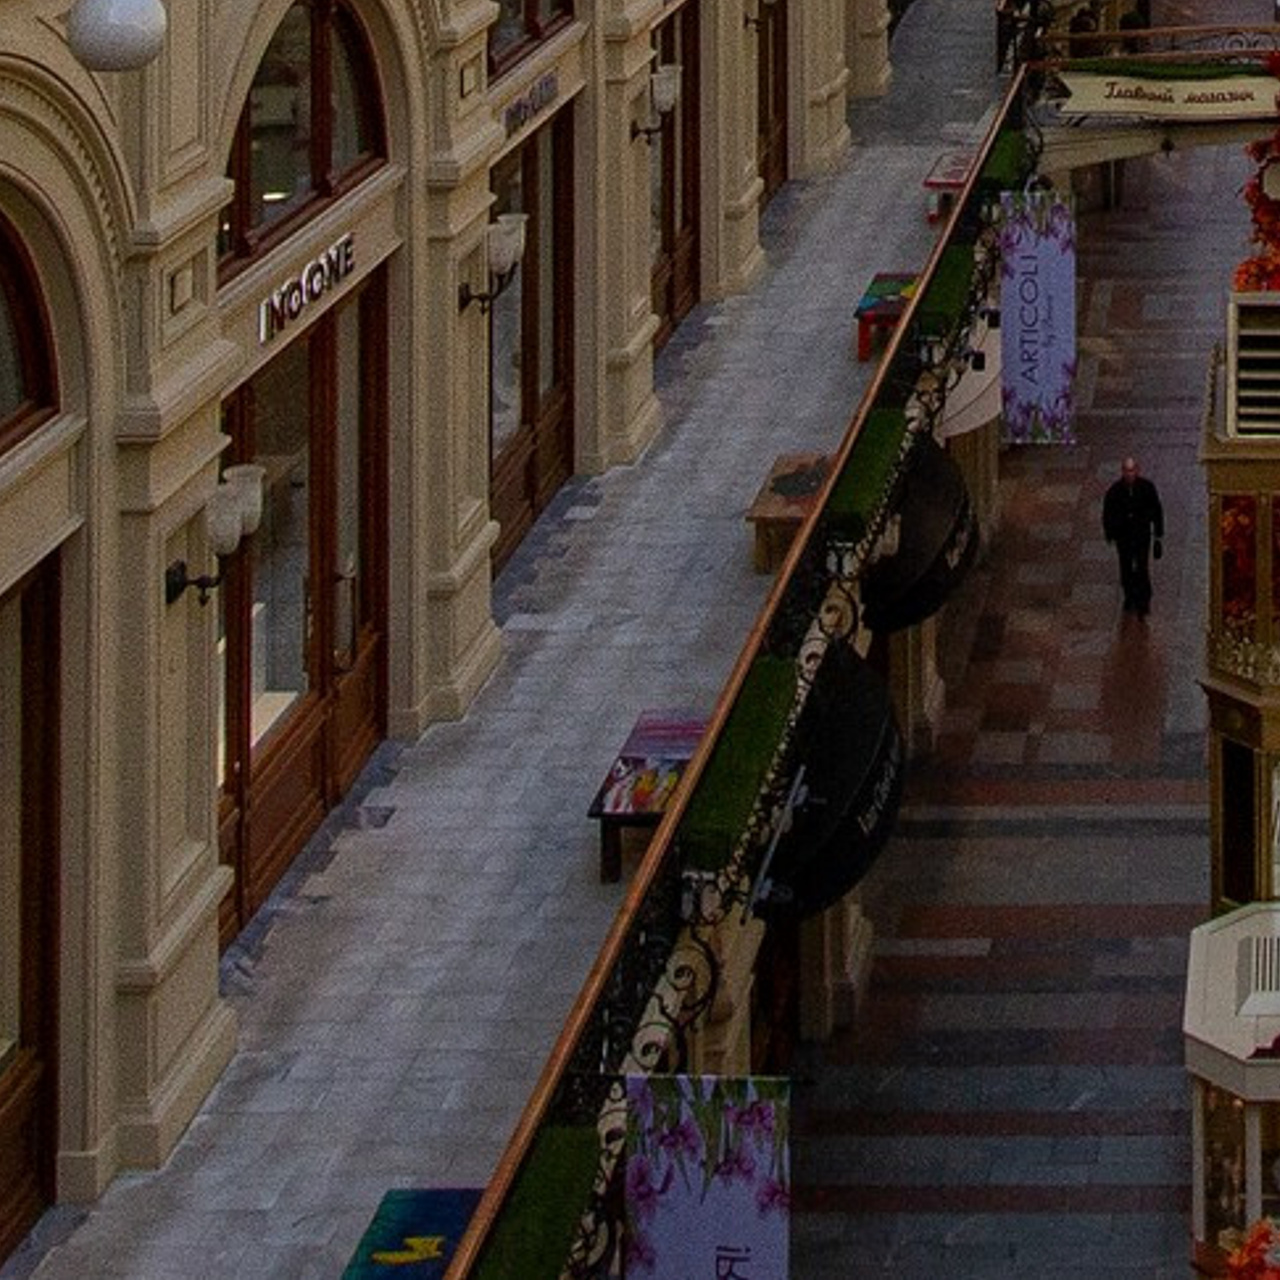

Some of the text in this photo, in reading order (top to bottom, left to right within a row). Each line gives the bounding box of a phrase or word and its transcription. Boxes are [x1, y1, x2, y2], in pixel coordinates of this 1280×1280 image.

[1103, 81, 1175, 104] Главный
[1182, 90, 1255, 104] магазин
[1019, 254, 1040, 385] ARTICOLI
